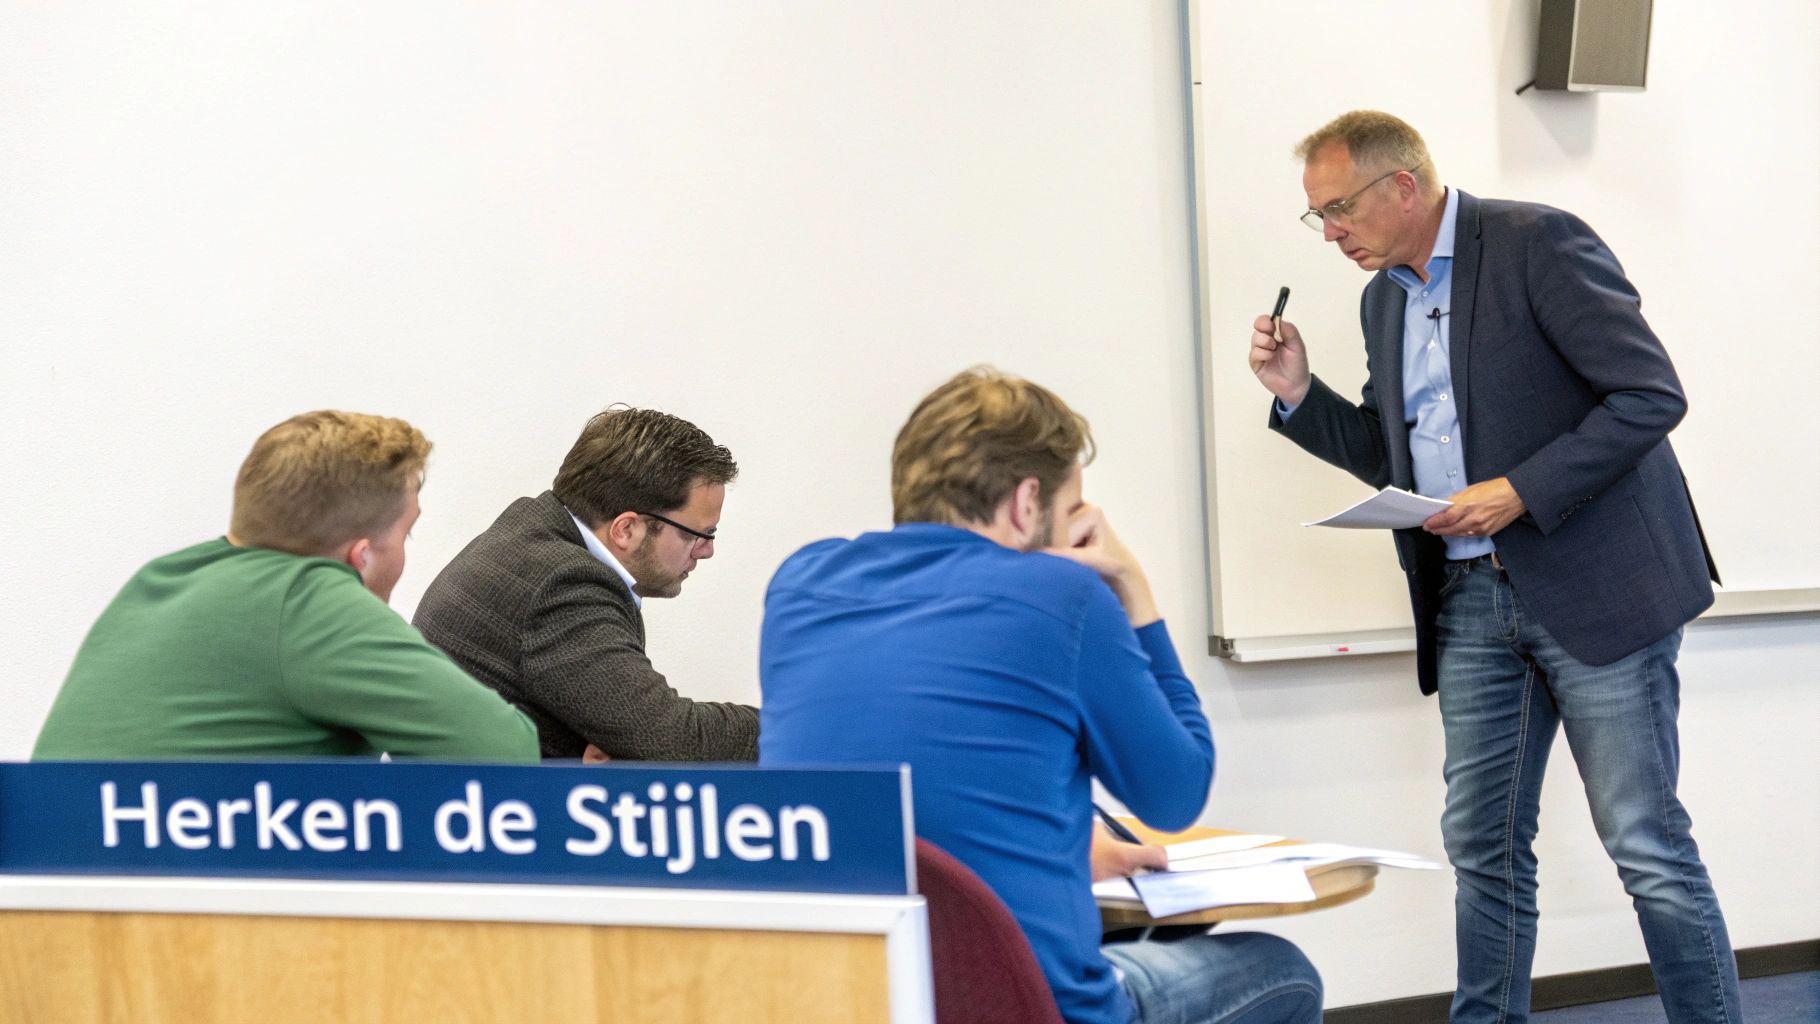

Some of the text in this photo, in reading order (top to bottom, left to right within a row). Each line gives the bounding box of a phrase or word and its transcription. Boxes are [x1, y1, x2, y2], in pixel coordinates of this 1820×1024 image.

[101, 780, 830, 875] Herken de Stijlen
